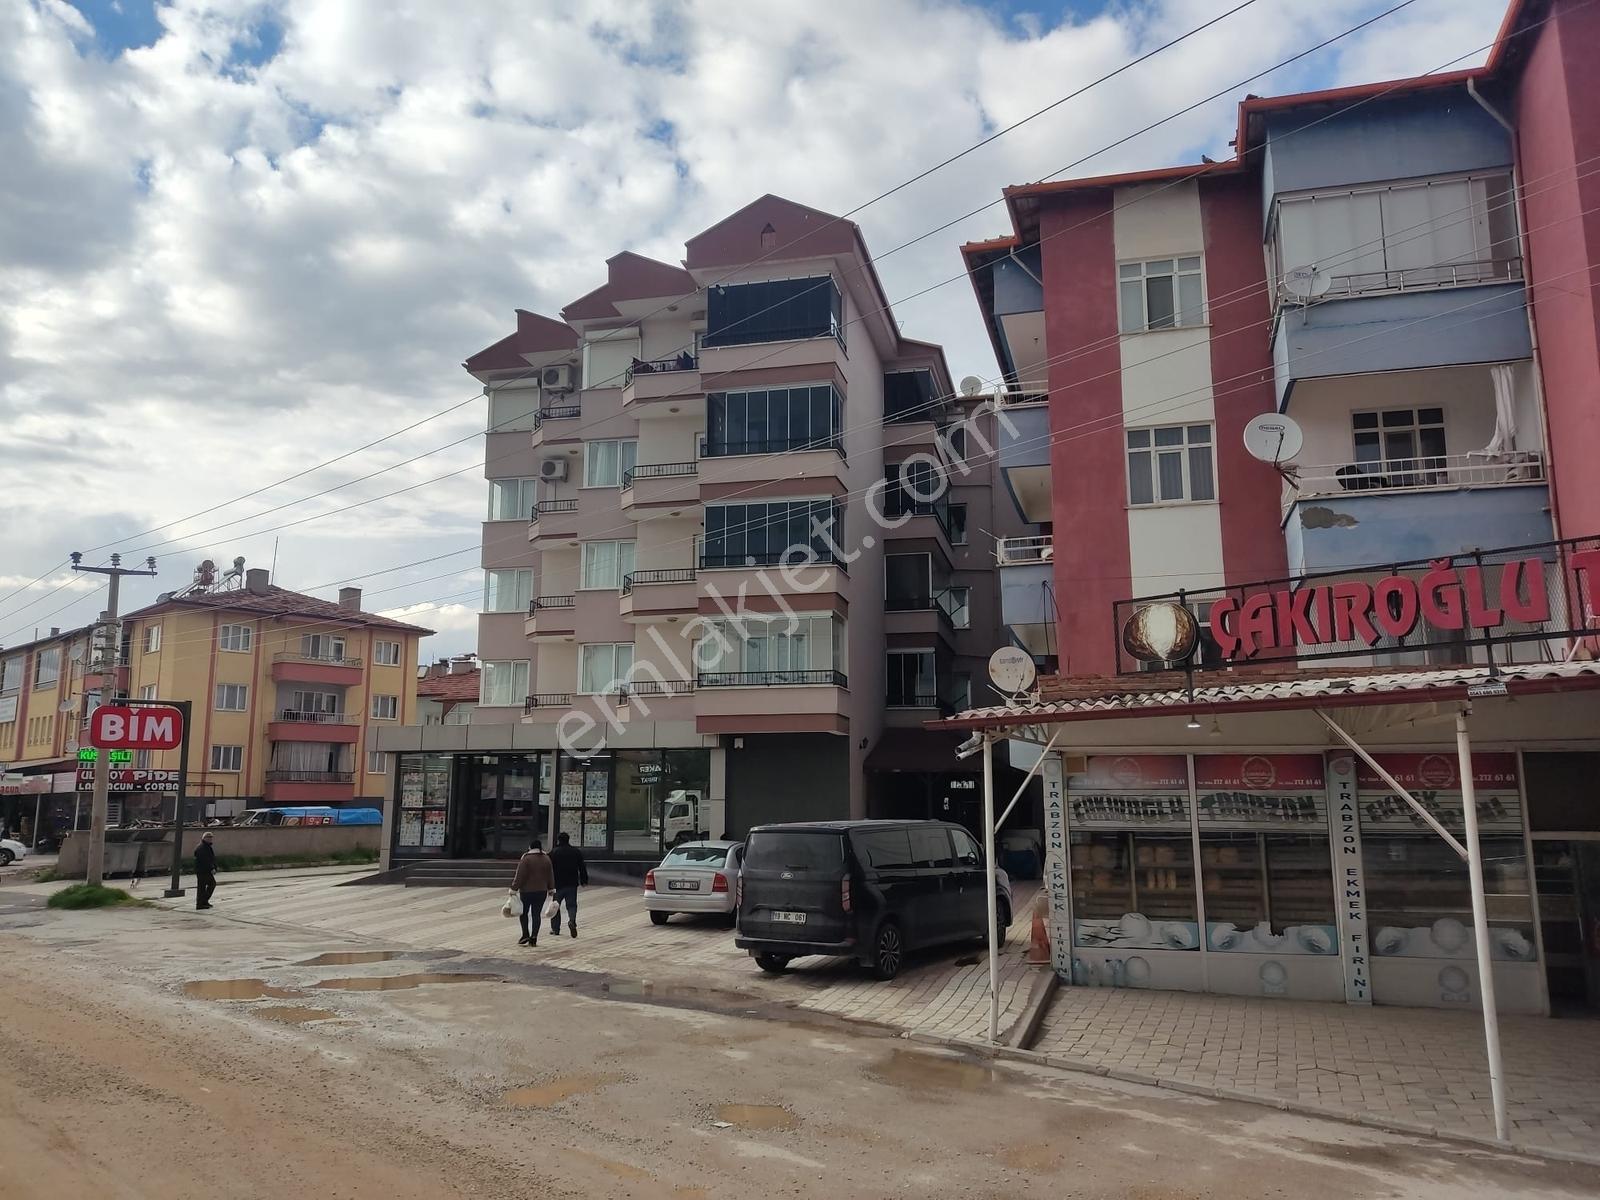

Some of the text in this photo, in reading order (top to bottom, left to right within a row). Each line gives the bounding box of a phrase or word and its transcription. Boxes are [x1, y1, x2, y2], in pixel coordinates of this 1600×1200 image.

[1209, 557, 1552, 660] ÇAKIROĞLU
[81, 770, 125, 780] ULOY
[1049, 781, 1062, 849] TRABZON
[1052, 862, 1065, 911] EKMEK
[1338, 782, 1367, 998] TRABZON EKMEK FIRINI
